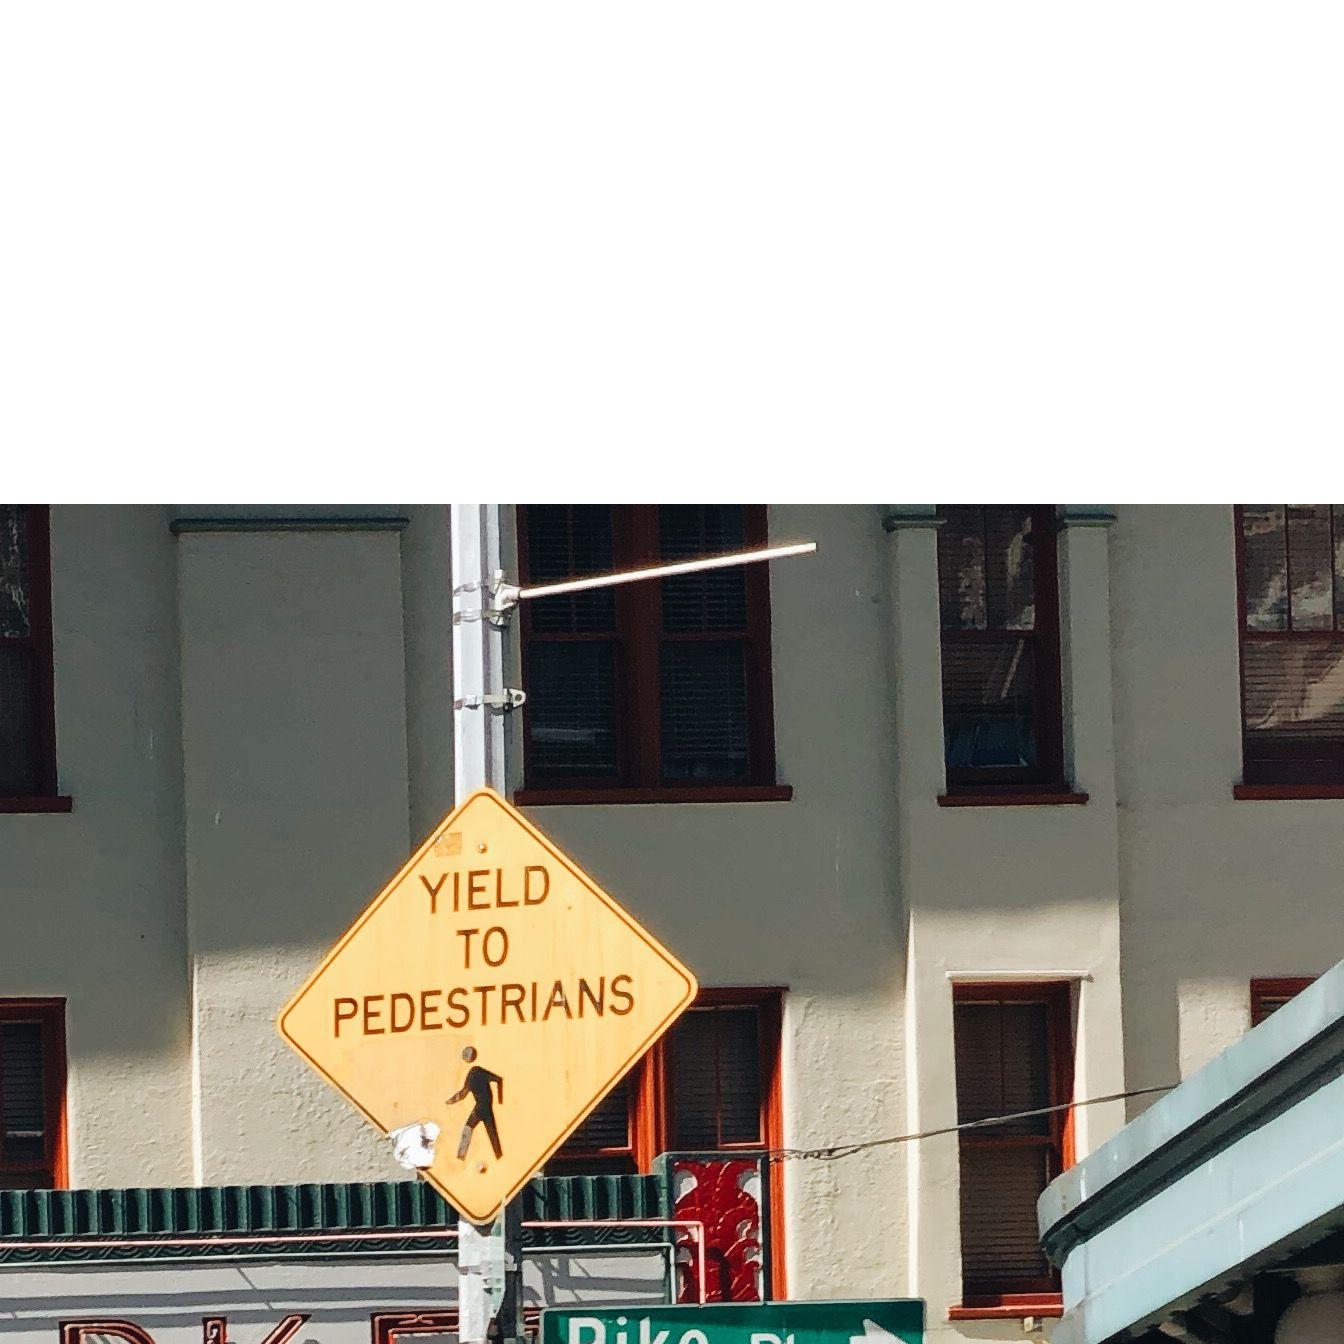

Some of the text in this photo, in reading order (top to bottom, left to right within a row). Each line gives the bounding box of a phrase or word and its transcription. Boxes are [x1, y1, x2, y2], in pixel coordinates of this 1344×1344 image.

[419, 864, 551, 915] YIELD
[456, 926, 510, 969] TO
[332, 974, 635, 1039] PEDESTRIANS
